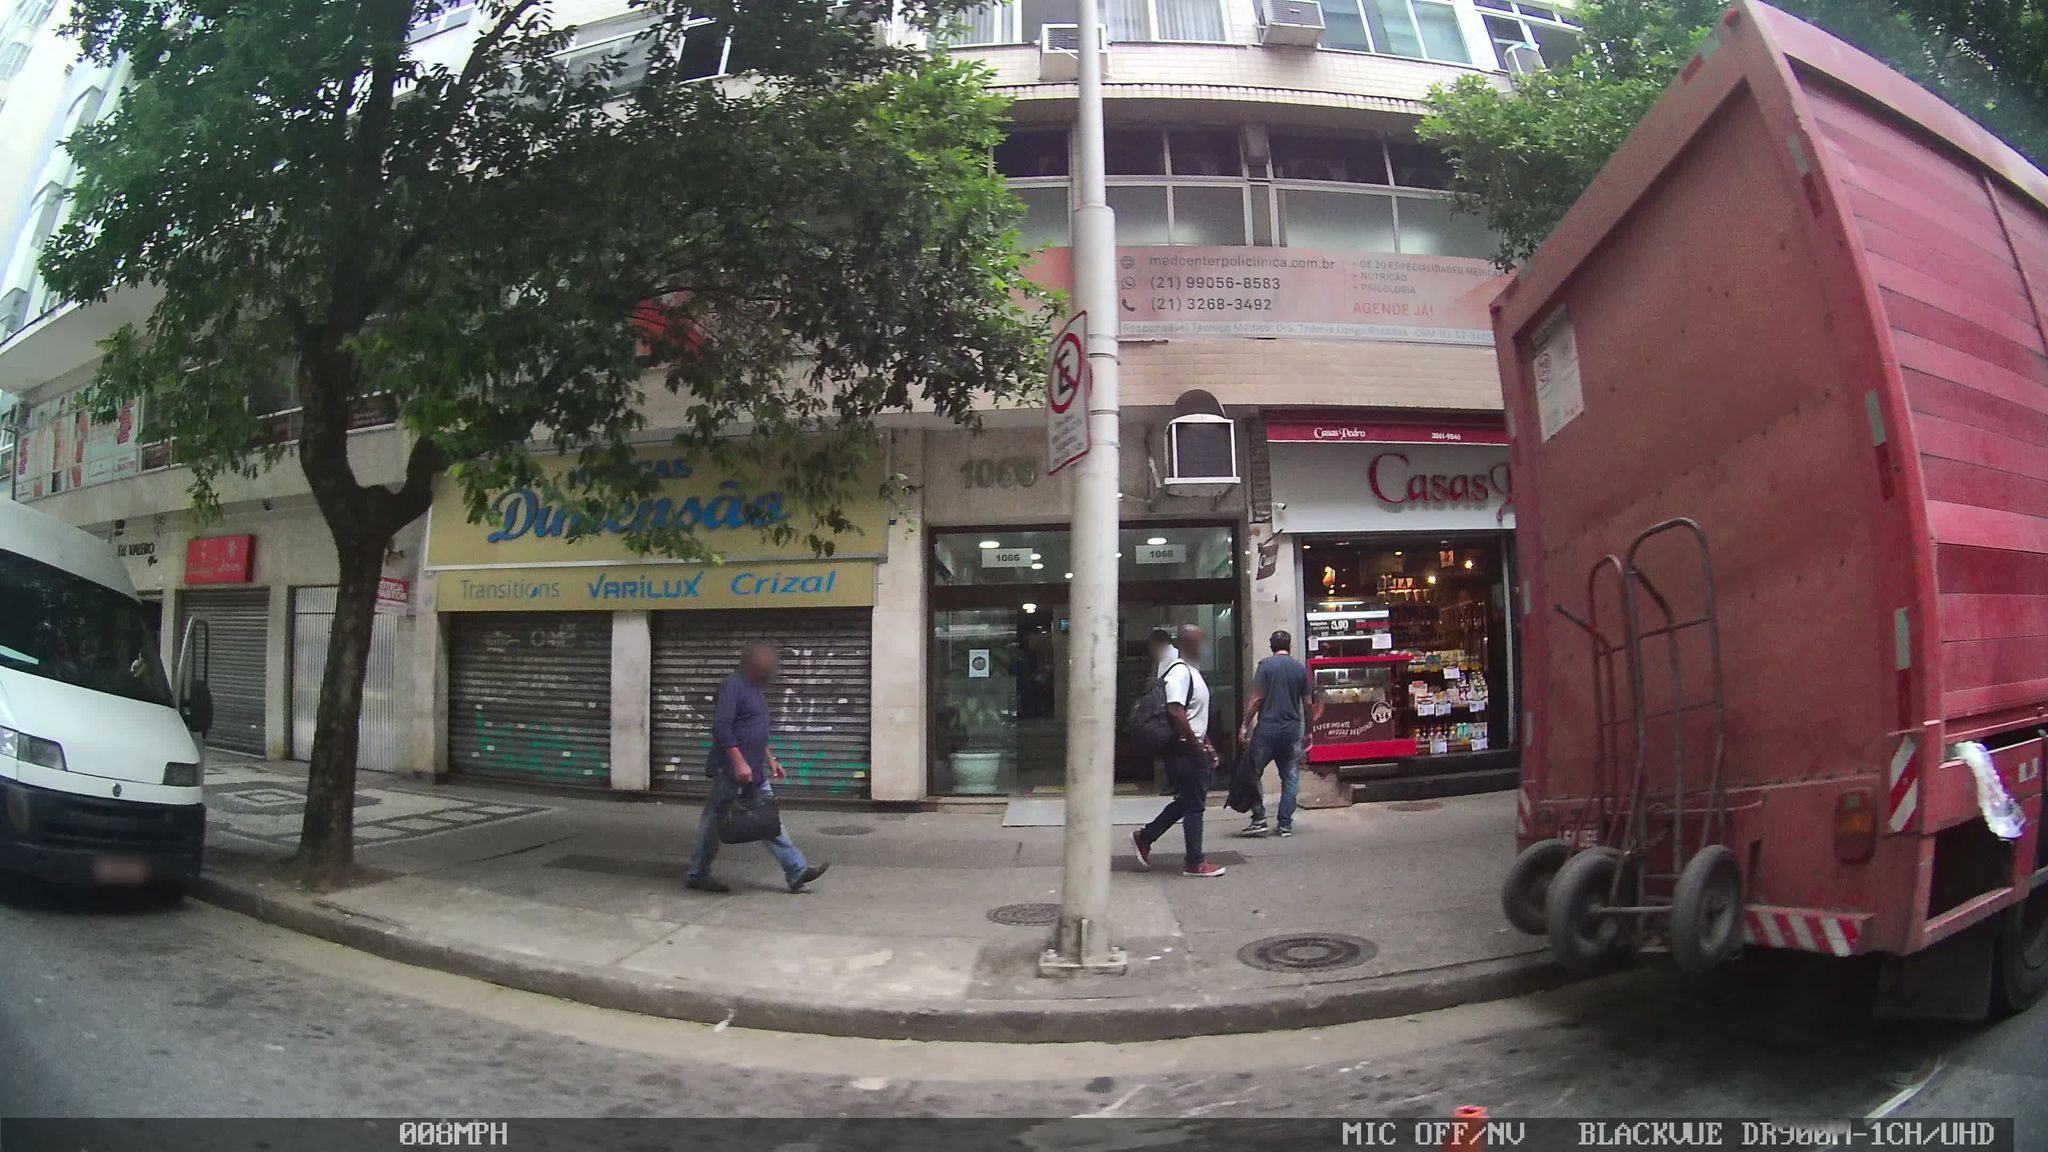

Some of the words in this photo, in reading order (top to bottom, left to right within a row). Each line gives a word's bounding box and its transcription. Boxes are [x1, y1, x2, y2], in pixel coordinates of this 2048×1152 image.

[1149, 255, 1335, 270] medcenterpoliclinica.com.br
[1149, 276, 1181, 290] (21)
[1186, 276, 1281, 290] 99056-8583
[1151, 298, 1182, 311] (21)
[1187, 298, 1272, 311] 3268-3492
[1354, 302, 1409, 316] AGENDE
[1313, 426, 1338, 439] Casas
[1338, 427, 1366, 440] Pedro
[1366, 452, 1489, 504] Casas
[460, 579, 560, 599] Transitions
[730, 571, 837, 597] Crizal
